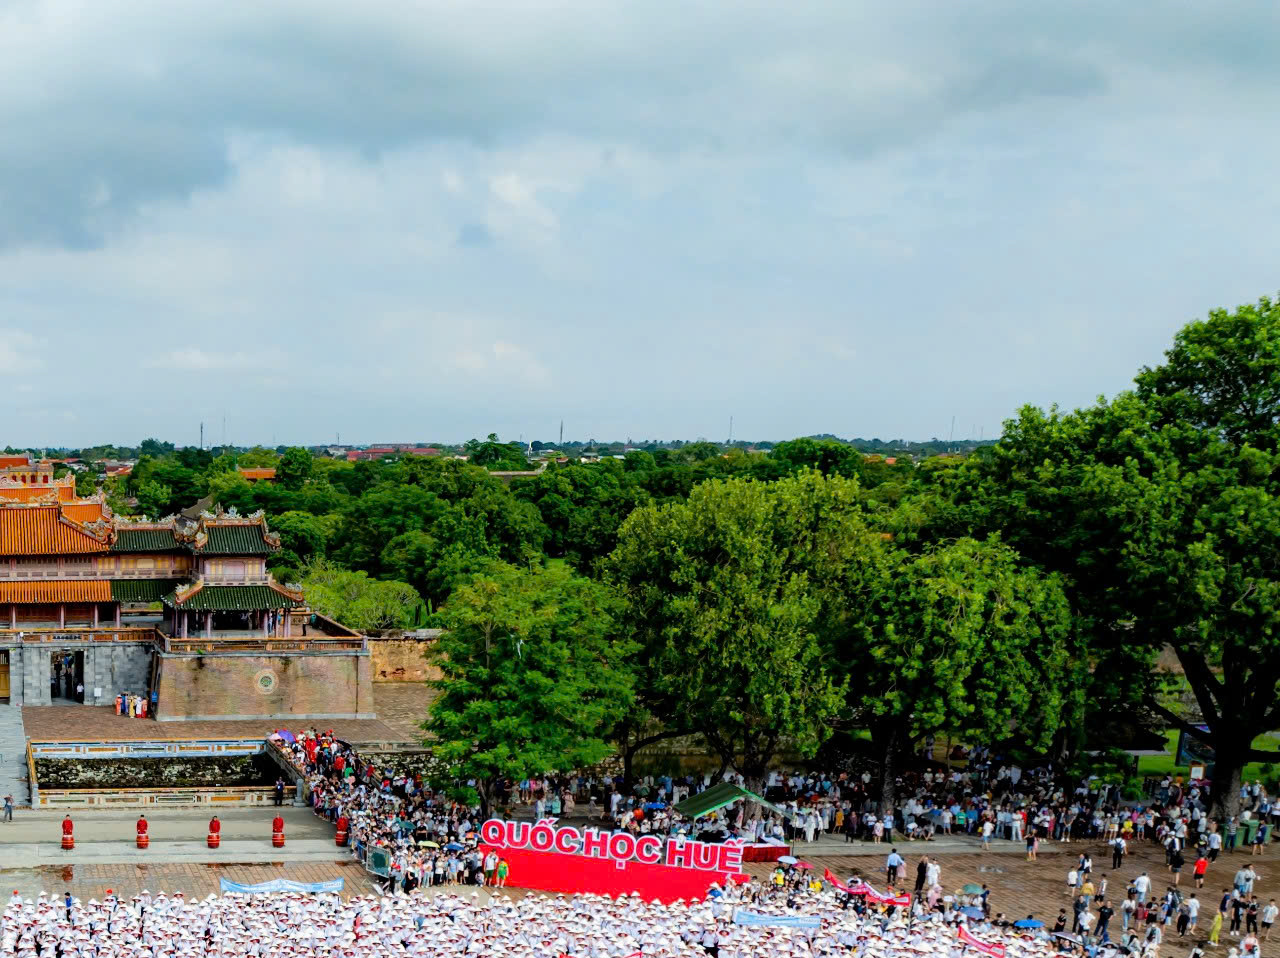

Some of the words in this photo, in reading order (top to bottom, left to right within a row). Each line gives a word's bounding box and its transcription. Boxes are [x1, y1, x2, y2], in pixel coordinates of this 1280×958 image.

[481, 818, 581, 855] QUỐC
[583, 829, 662, 870] HỌC
[666, 837, 747, 874] HUẾ
